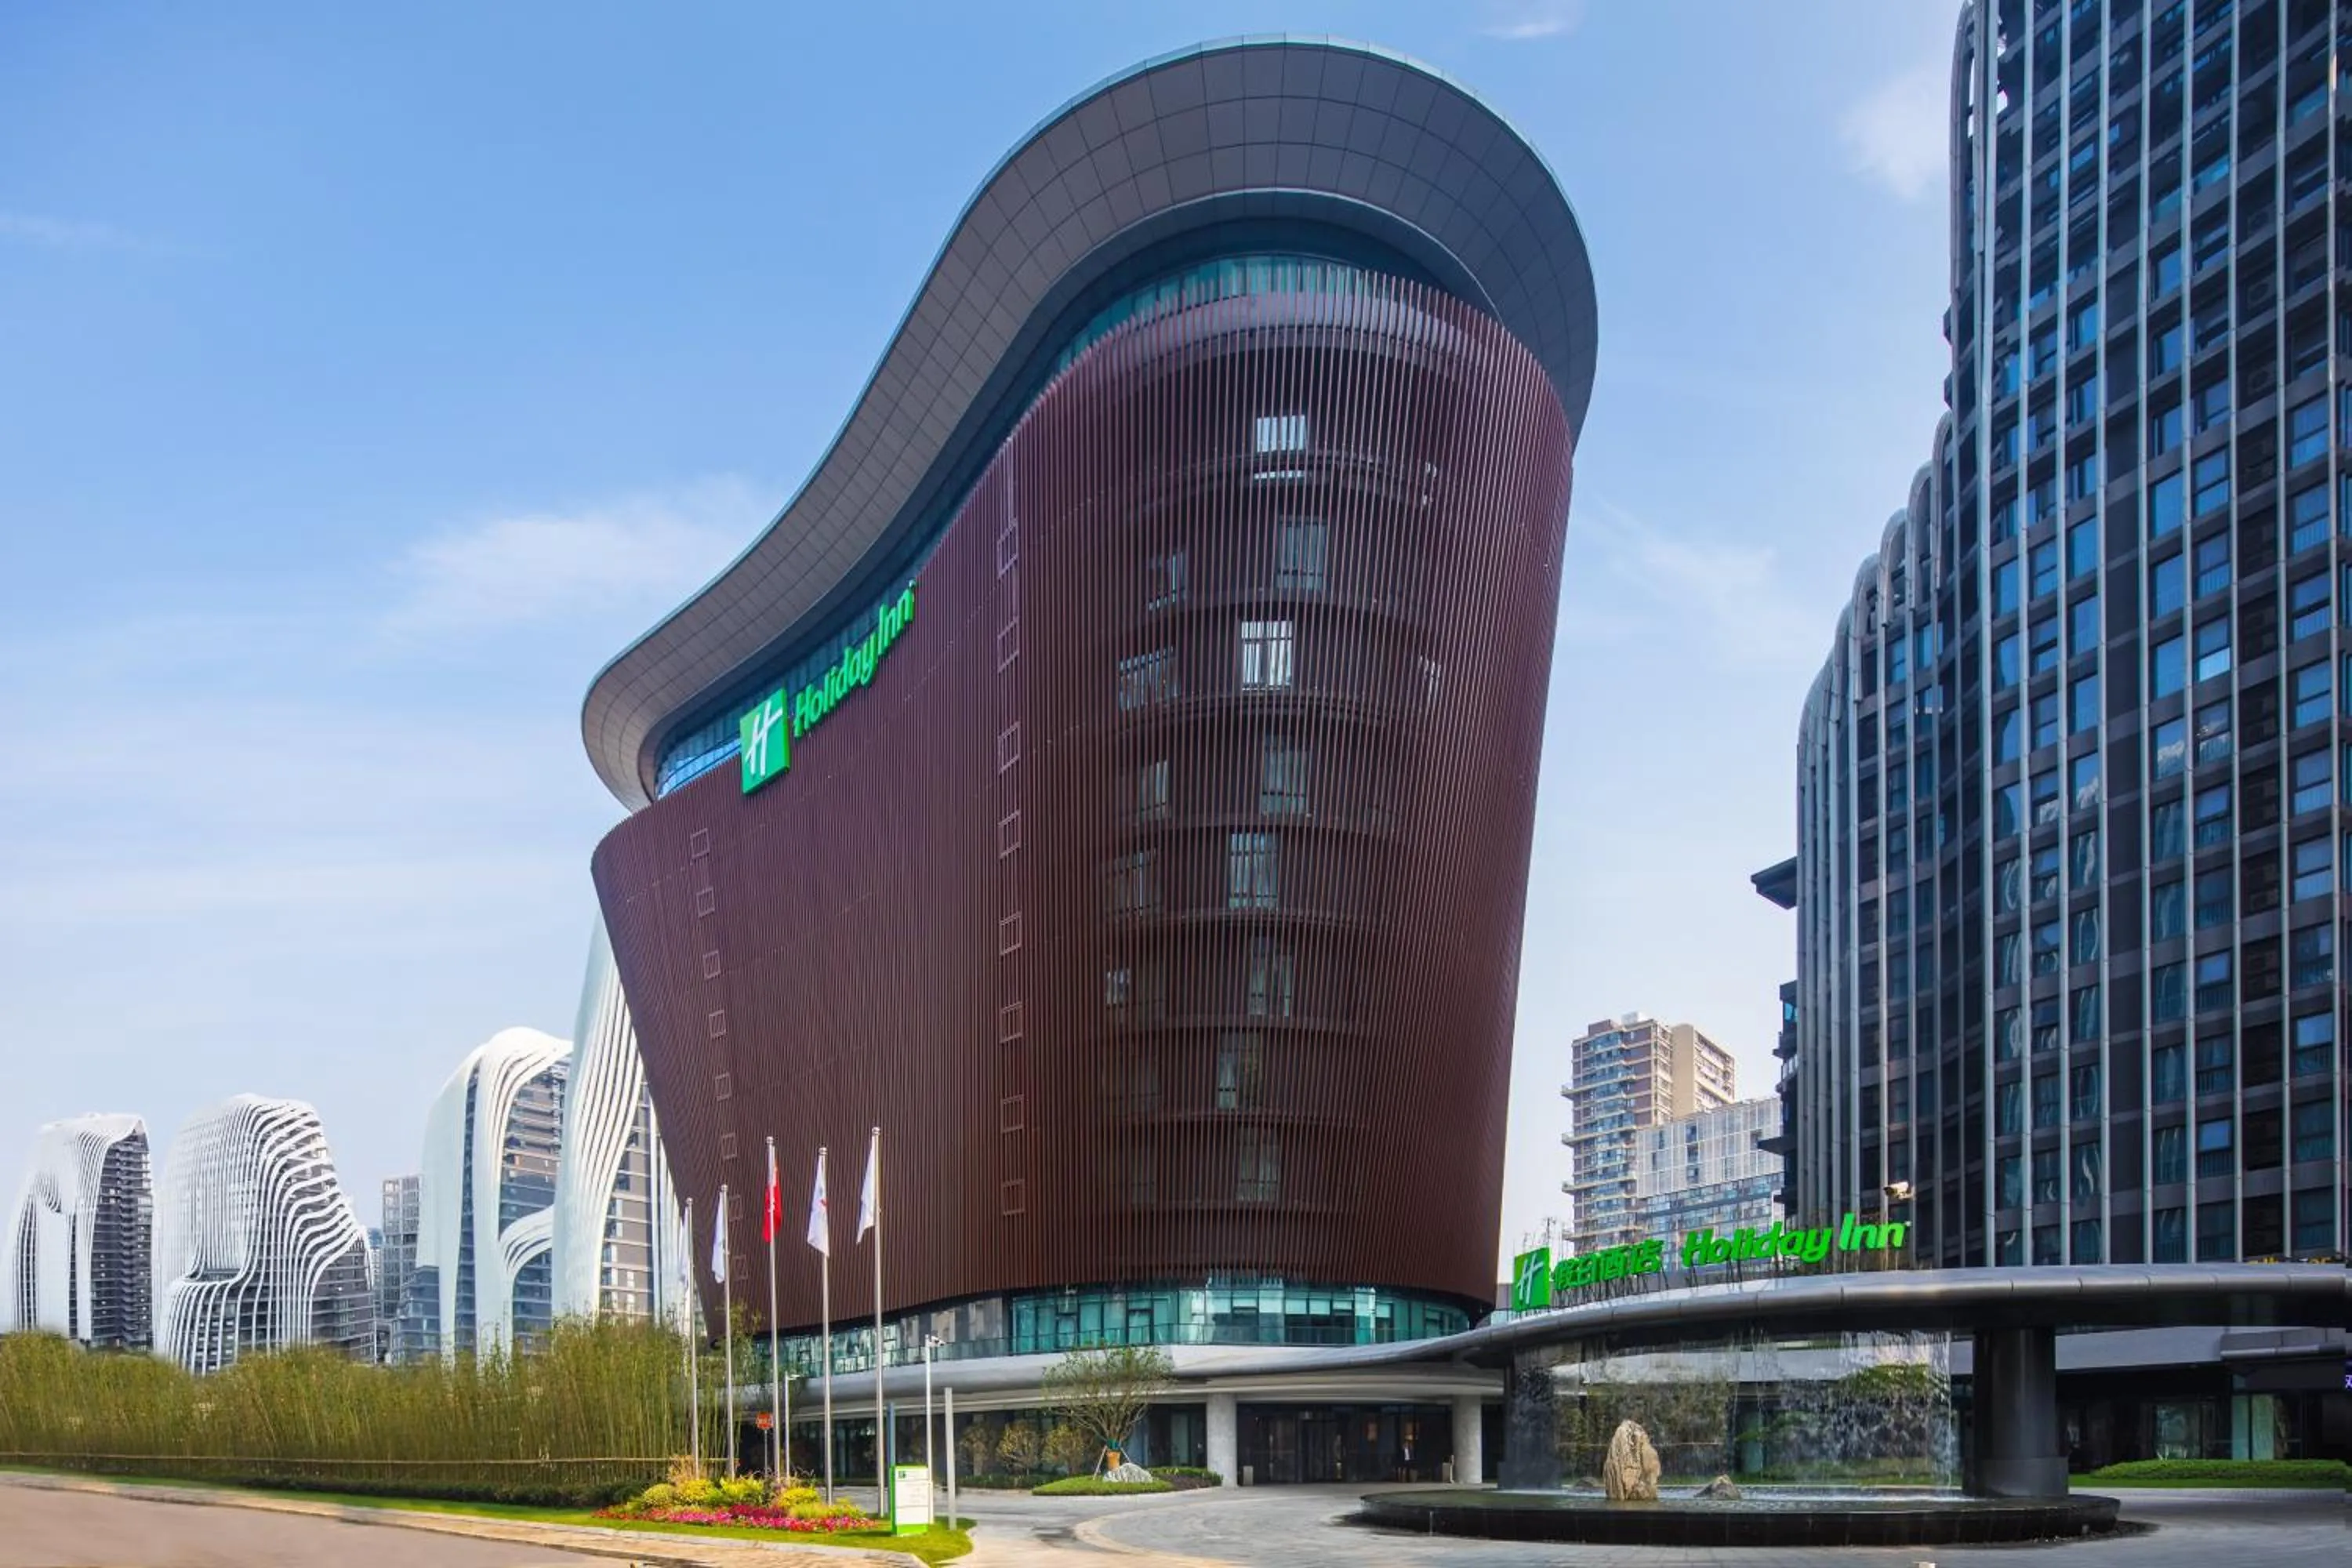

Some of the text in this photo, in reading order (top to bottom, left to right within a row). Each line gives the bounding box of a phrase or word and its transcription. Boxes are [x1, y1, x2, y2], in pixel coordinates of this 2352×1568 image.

[793, 631, 879, 738] Holiday
[878, 589, 915, 656] Inn
[1553, 1240, 1663, 1290] 假日酒店
[1682, 1221, 1832, 1267] Holiday
[1838, 1212, 1905, 1250] Inn
